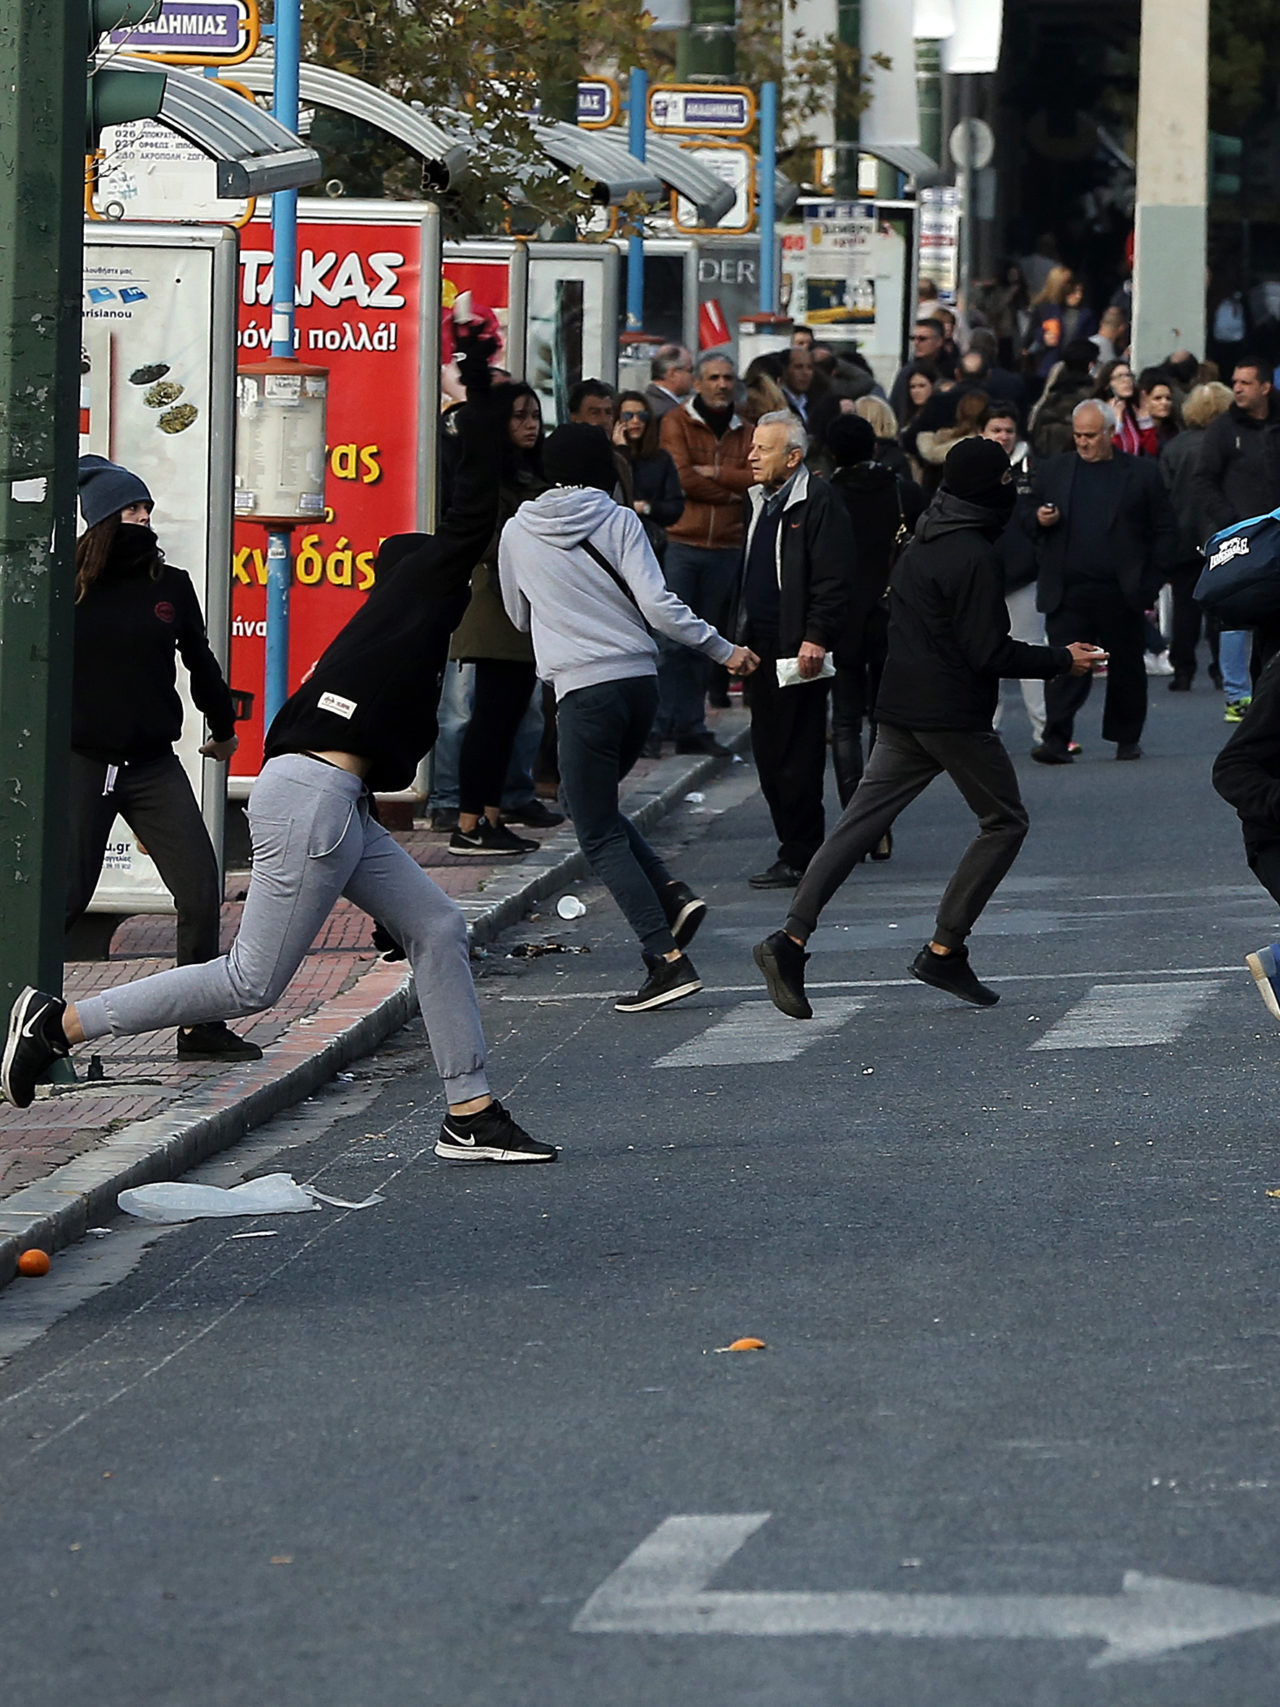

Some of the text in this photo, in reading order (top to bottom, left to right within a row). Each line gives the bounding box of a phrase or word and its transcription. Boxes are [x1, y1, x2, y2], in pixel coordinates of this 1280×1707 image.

[119, 14, 228, 35] ΑΔΗΜΙΑΣ
[308, 321, 398, 351] πολλά!
[324, 443, 380, 483] ας
